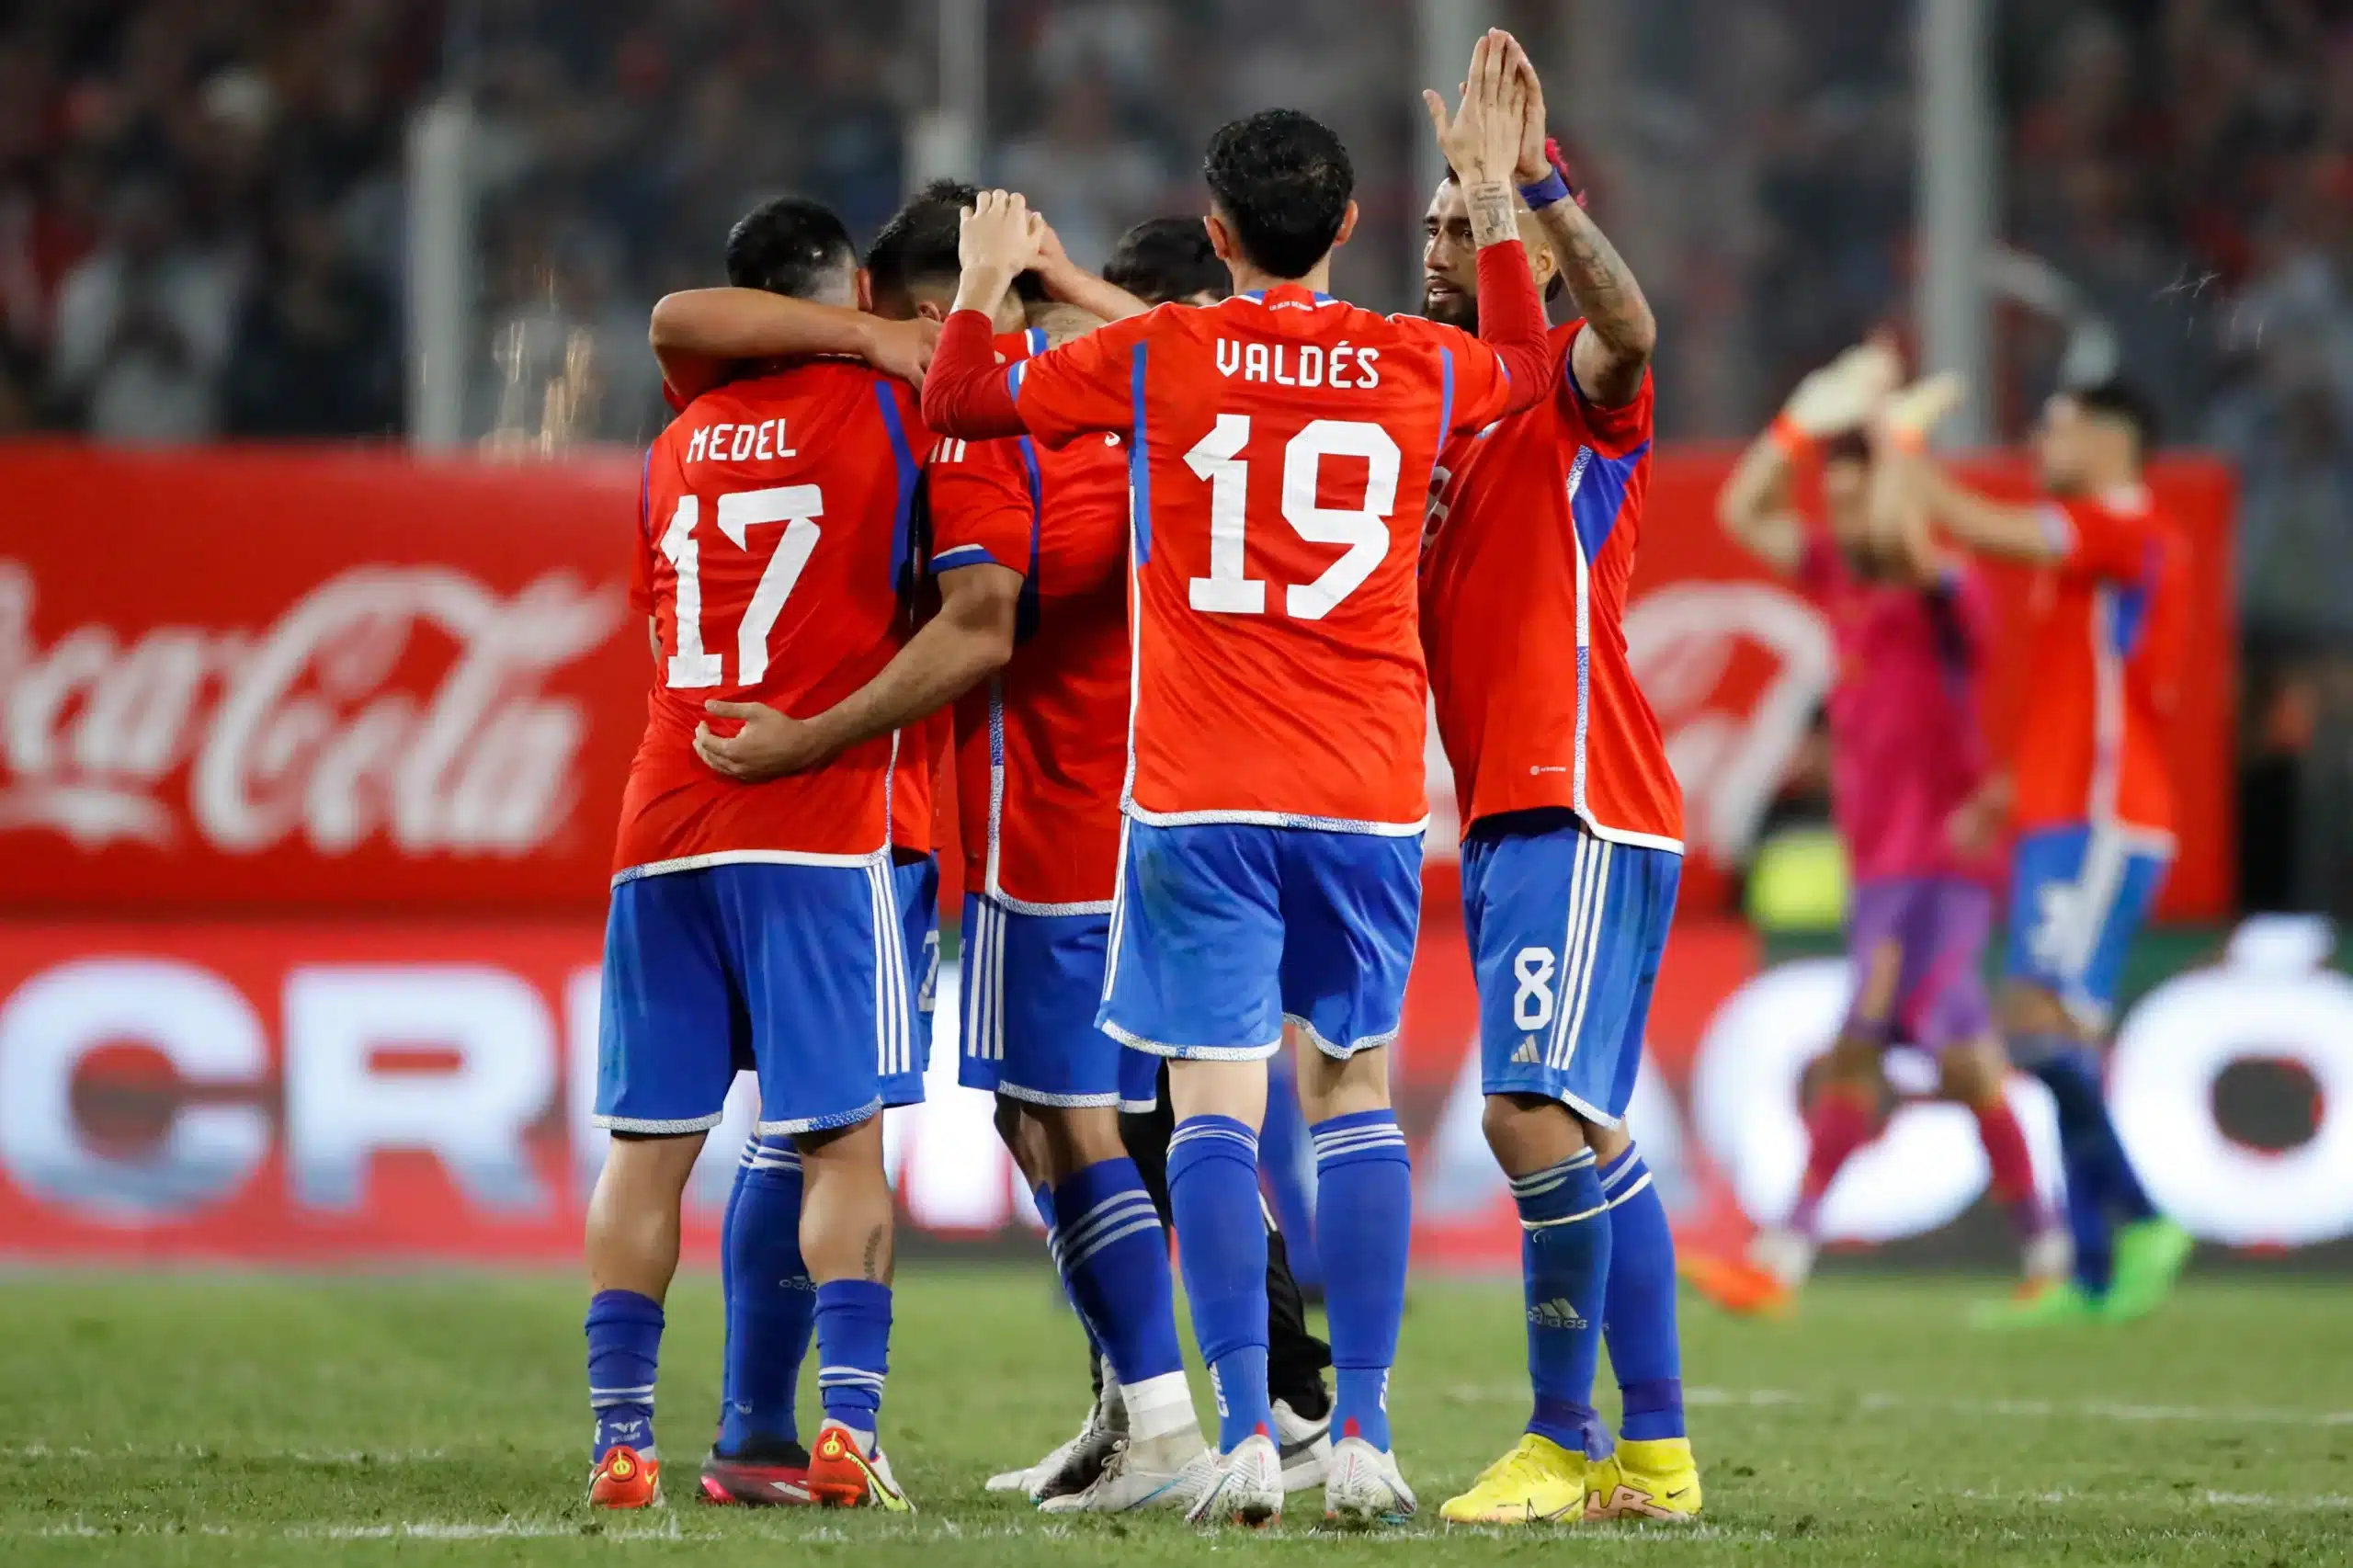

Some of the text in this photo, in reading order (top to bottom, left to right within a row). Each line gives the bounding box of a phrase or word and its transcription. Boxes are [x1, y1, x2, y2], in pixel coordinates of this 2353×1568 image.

[1215, 337, 1380, 389] VALDÉS
[686, 418, 797, 463] MEDEL
[1182, 413, 1402, 620] 19
[660, 483, 824, 688] 17
[1513, 947, 1555, 1031] 8
